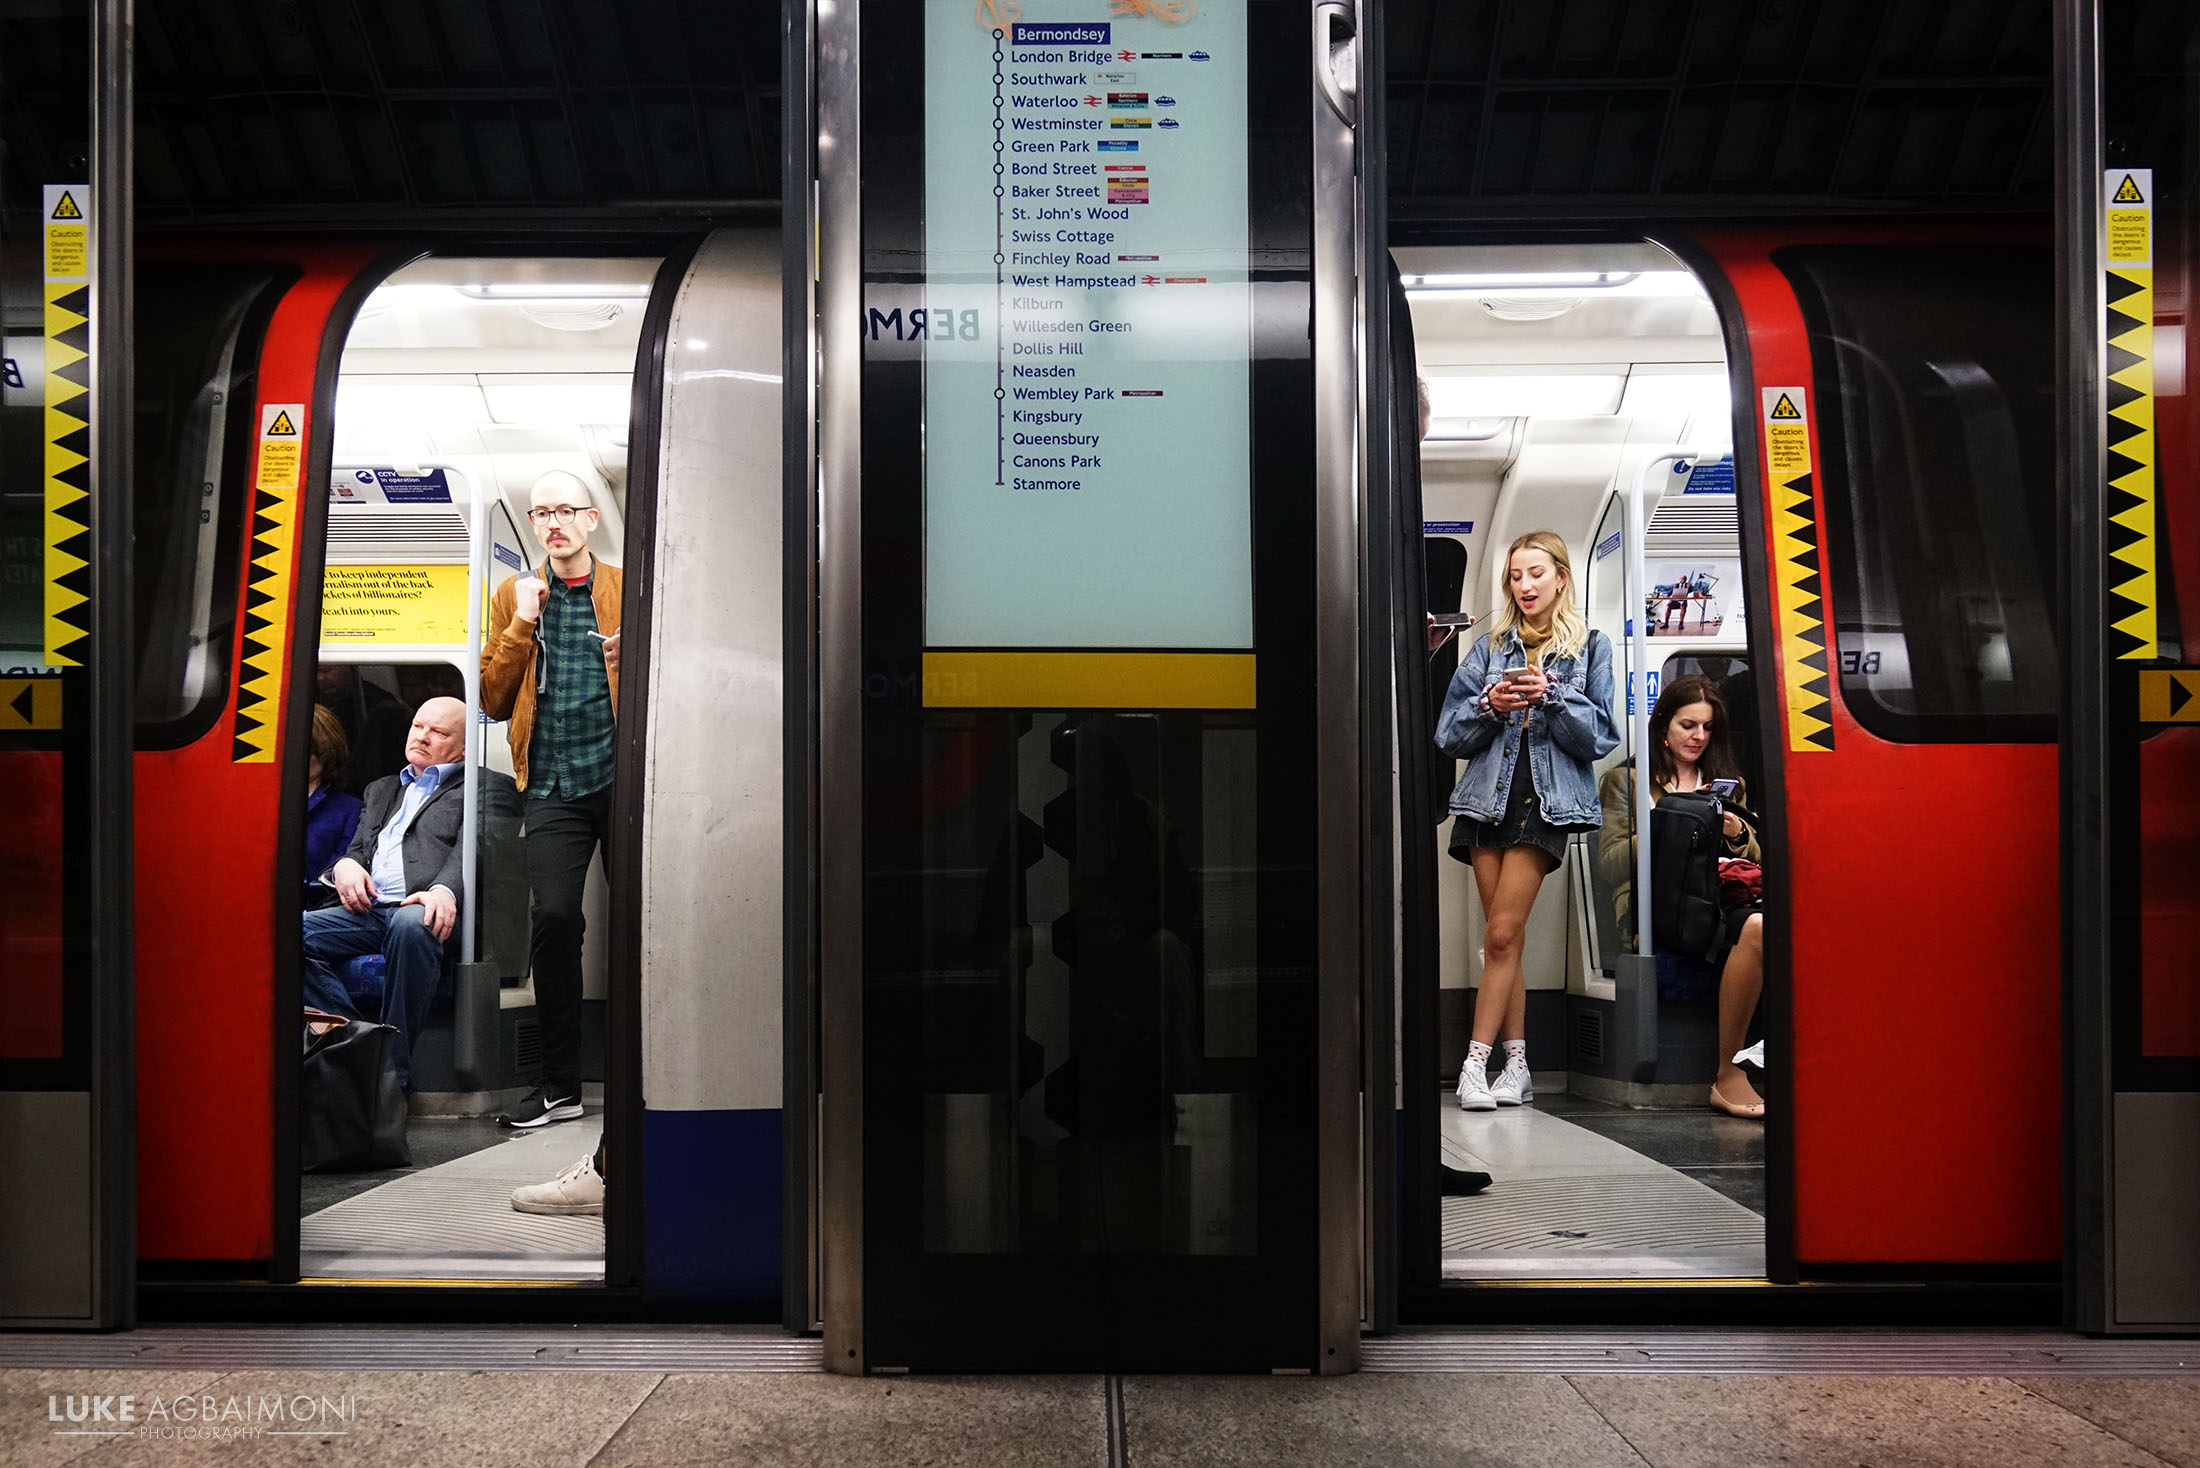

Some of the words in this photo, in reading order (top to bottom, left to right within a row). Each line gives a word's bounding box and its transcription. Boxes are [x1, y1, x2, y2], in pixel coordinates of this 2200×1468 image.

[1017, 28, 1105, 43] Bermondsey
[1012, 51, 1063, 62] London
[1069, 50, 1112, 65] Bridge
[1012, 73, 1086, 85] Southwark
[1012, 95, 1078, 107] Waterloo
[1012, 118, 1103, 130] Westminster
[1012, 140, 1054, 152] Green
[1061, 140, 1089, 152] Park
[1012, 163, 1047, 175] Bond
[1053, 163, 1097, 175] Street
[1013, 185, 1050, 197] Baker
[1056, 185, 1100, 197] Street
[1012, 208, 1030, 220] St.
[1036, 208, 1081, 219] John's
[1087, 208, 1128, 219] Wood
[2112, 214, 2145, 222] Caution
[50, 230, 83, 238] Caution
[1012, 230, 1051, 242] Swiss
[1057, 230, 1114, 245] Cottage
[1013, 252, 1070, 267] Finchley
[1076, 252, 1110, 264] Road
[1012, 275, 1049, 287] West
[1056, 275, 1135, 290] Hampstead
[1013, 298, 1063, 309] Kilburn
[1014, 321, 1083, 332] Willesden
[1089, 320, 1131, 332] Green
[1013, 343, 1053, 355] Dollis
[1060, 343, 1083, 354] Hill
[1013, 365, 1075, 377] Neasden
[1013, 388, 1079, 402] Wembley
[1085, 388, 1114, 399] Park
[1014, 410, 1082, 425] Kingsbury
[1771, 428, 1804, 436] Caution
[1013, 433, 1099, 448] Queensbury
[1013, 455, 1065, 467] Canons
[1072, 455, 1101, 467] Park
[1013, 478, 1080, 490] Stanmore
[340, 571, 364, 580] keep
[365, 571, 429, 580] independent
[382, 581, 391, 589] of
[393, 581, 410, 589] the
[410, 581, 434, 589] back
[363, 591, 422, 599] billionaires?
[350, 607, 369, 615] into
[370, 608, 400, 617] yours.
